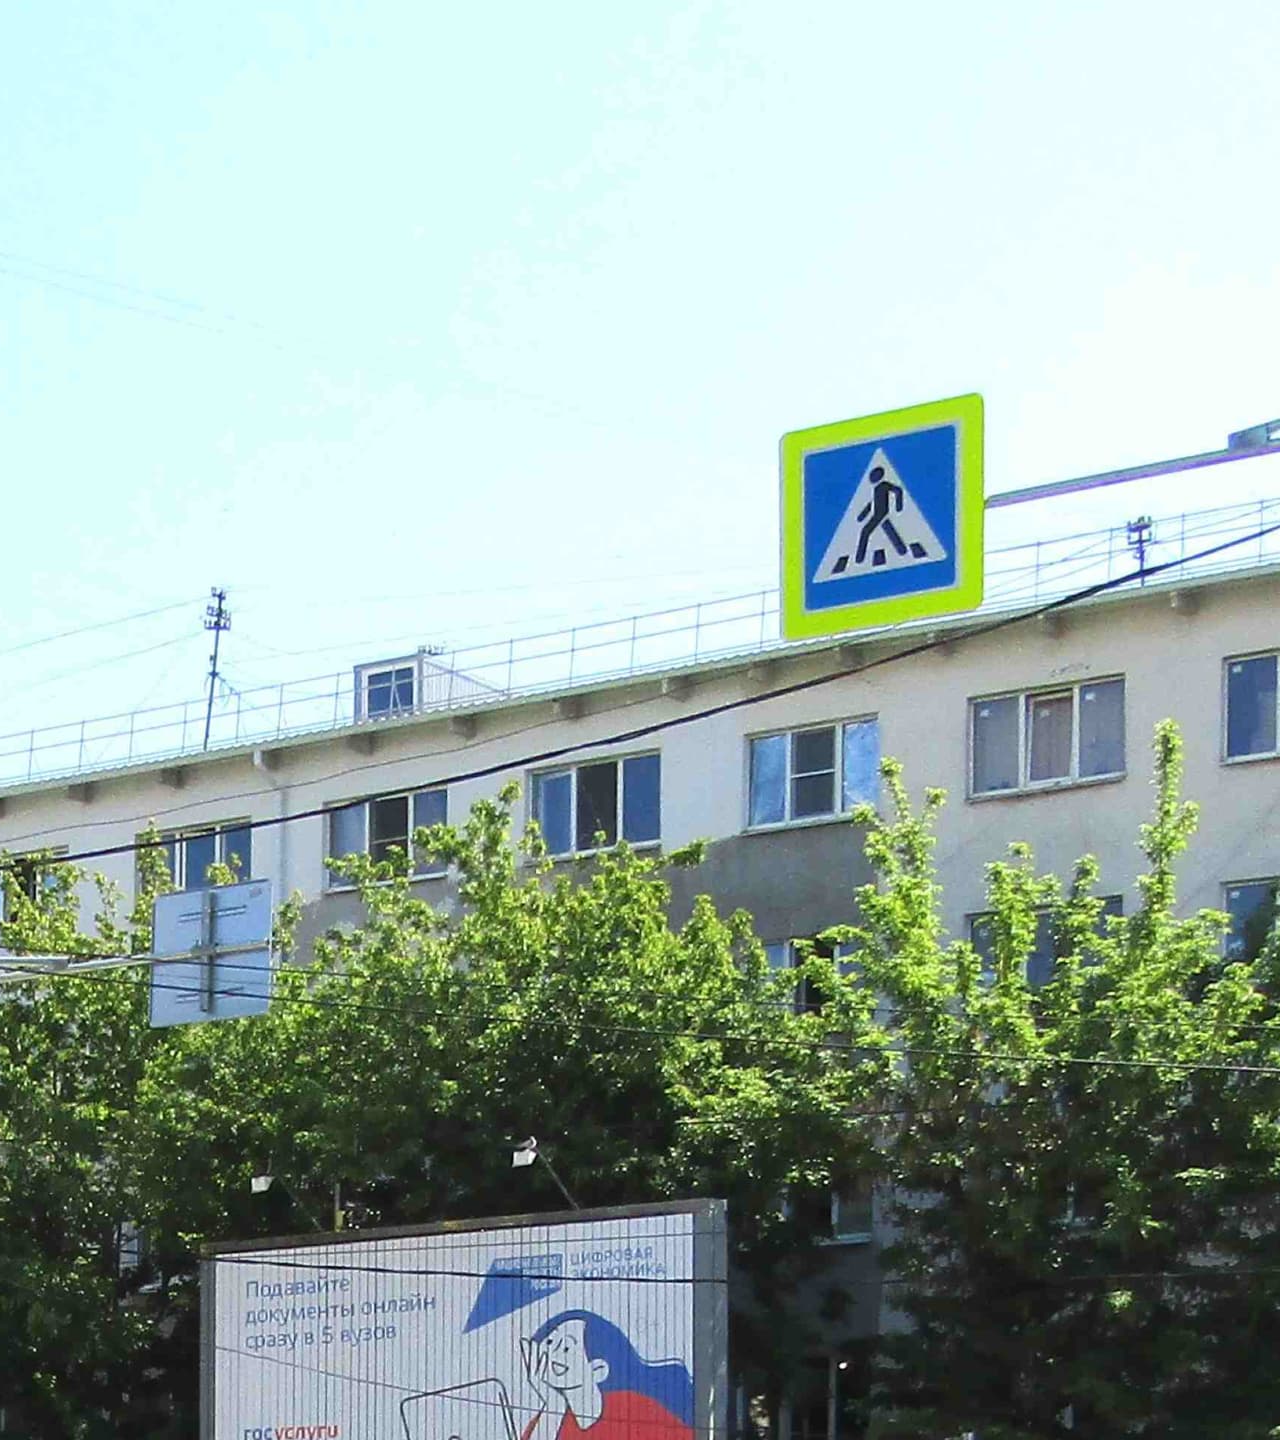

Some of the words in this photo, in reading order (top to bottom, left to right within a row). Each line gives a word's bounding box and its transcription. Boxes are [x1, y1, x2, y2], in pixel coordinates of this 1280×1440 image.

[245, 1275, 351, 1299] Подавайте
[244, 1303, 355, 1328] документы
[360, 1293, 437, 1316] онлайн
[244, 1329, 298, 1351] сразу
[304, 1333, 314, 1346] в
[321, 1326, 334, 1345] 5
[340, 1325, 397, 1347] вузов
